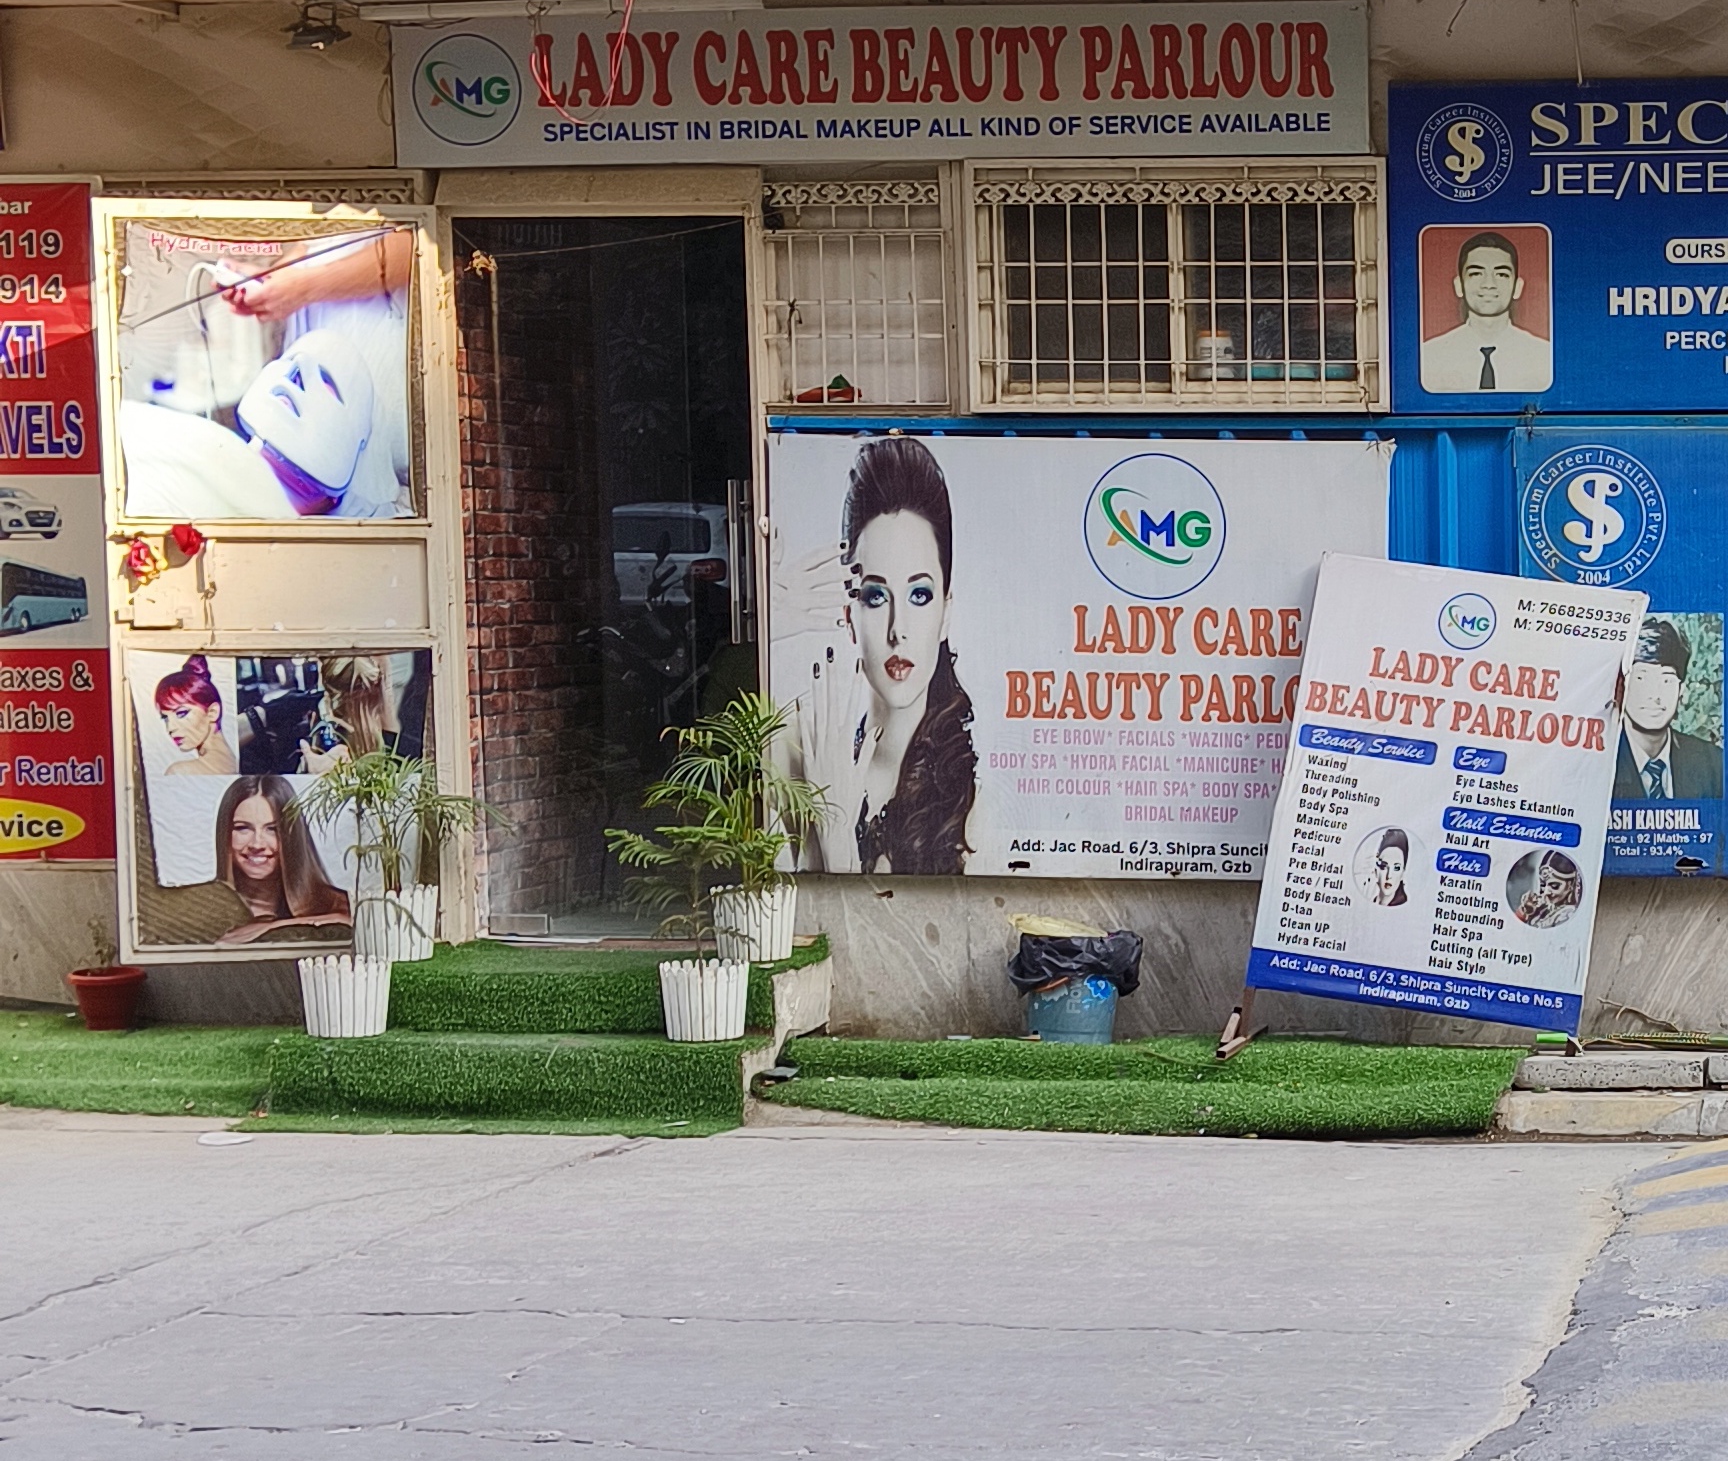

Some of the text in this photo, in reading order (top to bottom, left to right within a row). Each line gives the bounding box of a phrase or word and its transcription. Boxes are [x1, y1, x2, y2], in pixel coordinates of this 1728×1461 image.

[533, 21, 1335, 109] LADY CARE BEAUTY PARLOUR
[543, 112, 1331, 144] SPECIALIST IN BRIDAL MAKEUP ALL KIND OF SERVICE AVAILABLE
[1672, 243, 1727, 259] OURS
[1540, 602, 1631, 625] 7668259336
[1074, 605, 1302, 657] LADY CARE
[1369, 647, 1561, 702] LADY CARE
[1006, 670, 1170, 720] BEAUTY
[1305, 680, 1606, 752] BEAUTY PARLOUR
[1311, 729, 1426, 759] Beauty Service
[15, 755, 104, 786] Rental
[1125, 805, 1238, 823] BRIDAL MAKEUP
[1636, 809, 1700, 830] KAUSHAL
[1222, 859, 1252, 874] Gzb
